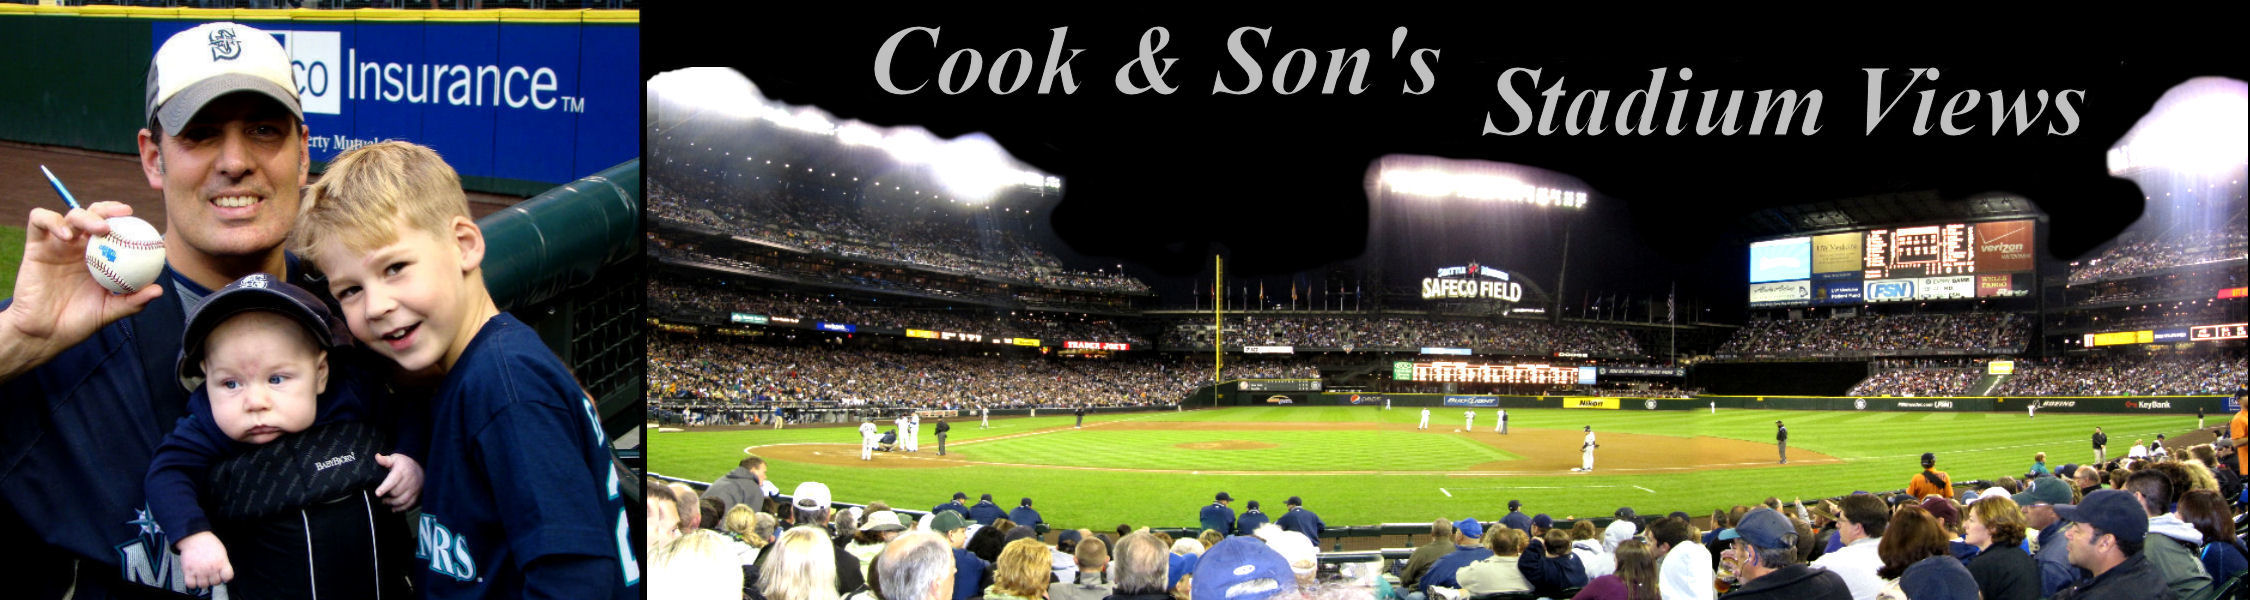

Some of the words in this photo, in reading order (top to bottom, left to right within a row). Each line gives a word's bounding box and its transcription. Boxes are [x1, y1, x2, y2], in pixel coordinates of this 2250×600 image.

[349, 48, 558, 110] Insurance
[1422, 277, 1478, 299] SAFECO
[1481, 280, 1522, 303] FIELD
[2138, 400, 2171, 409] KeyBank
